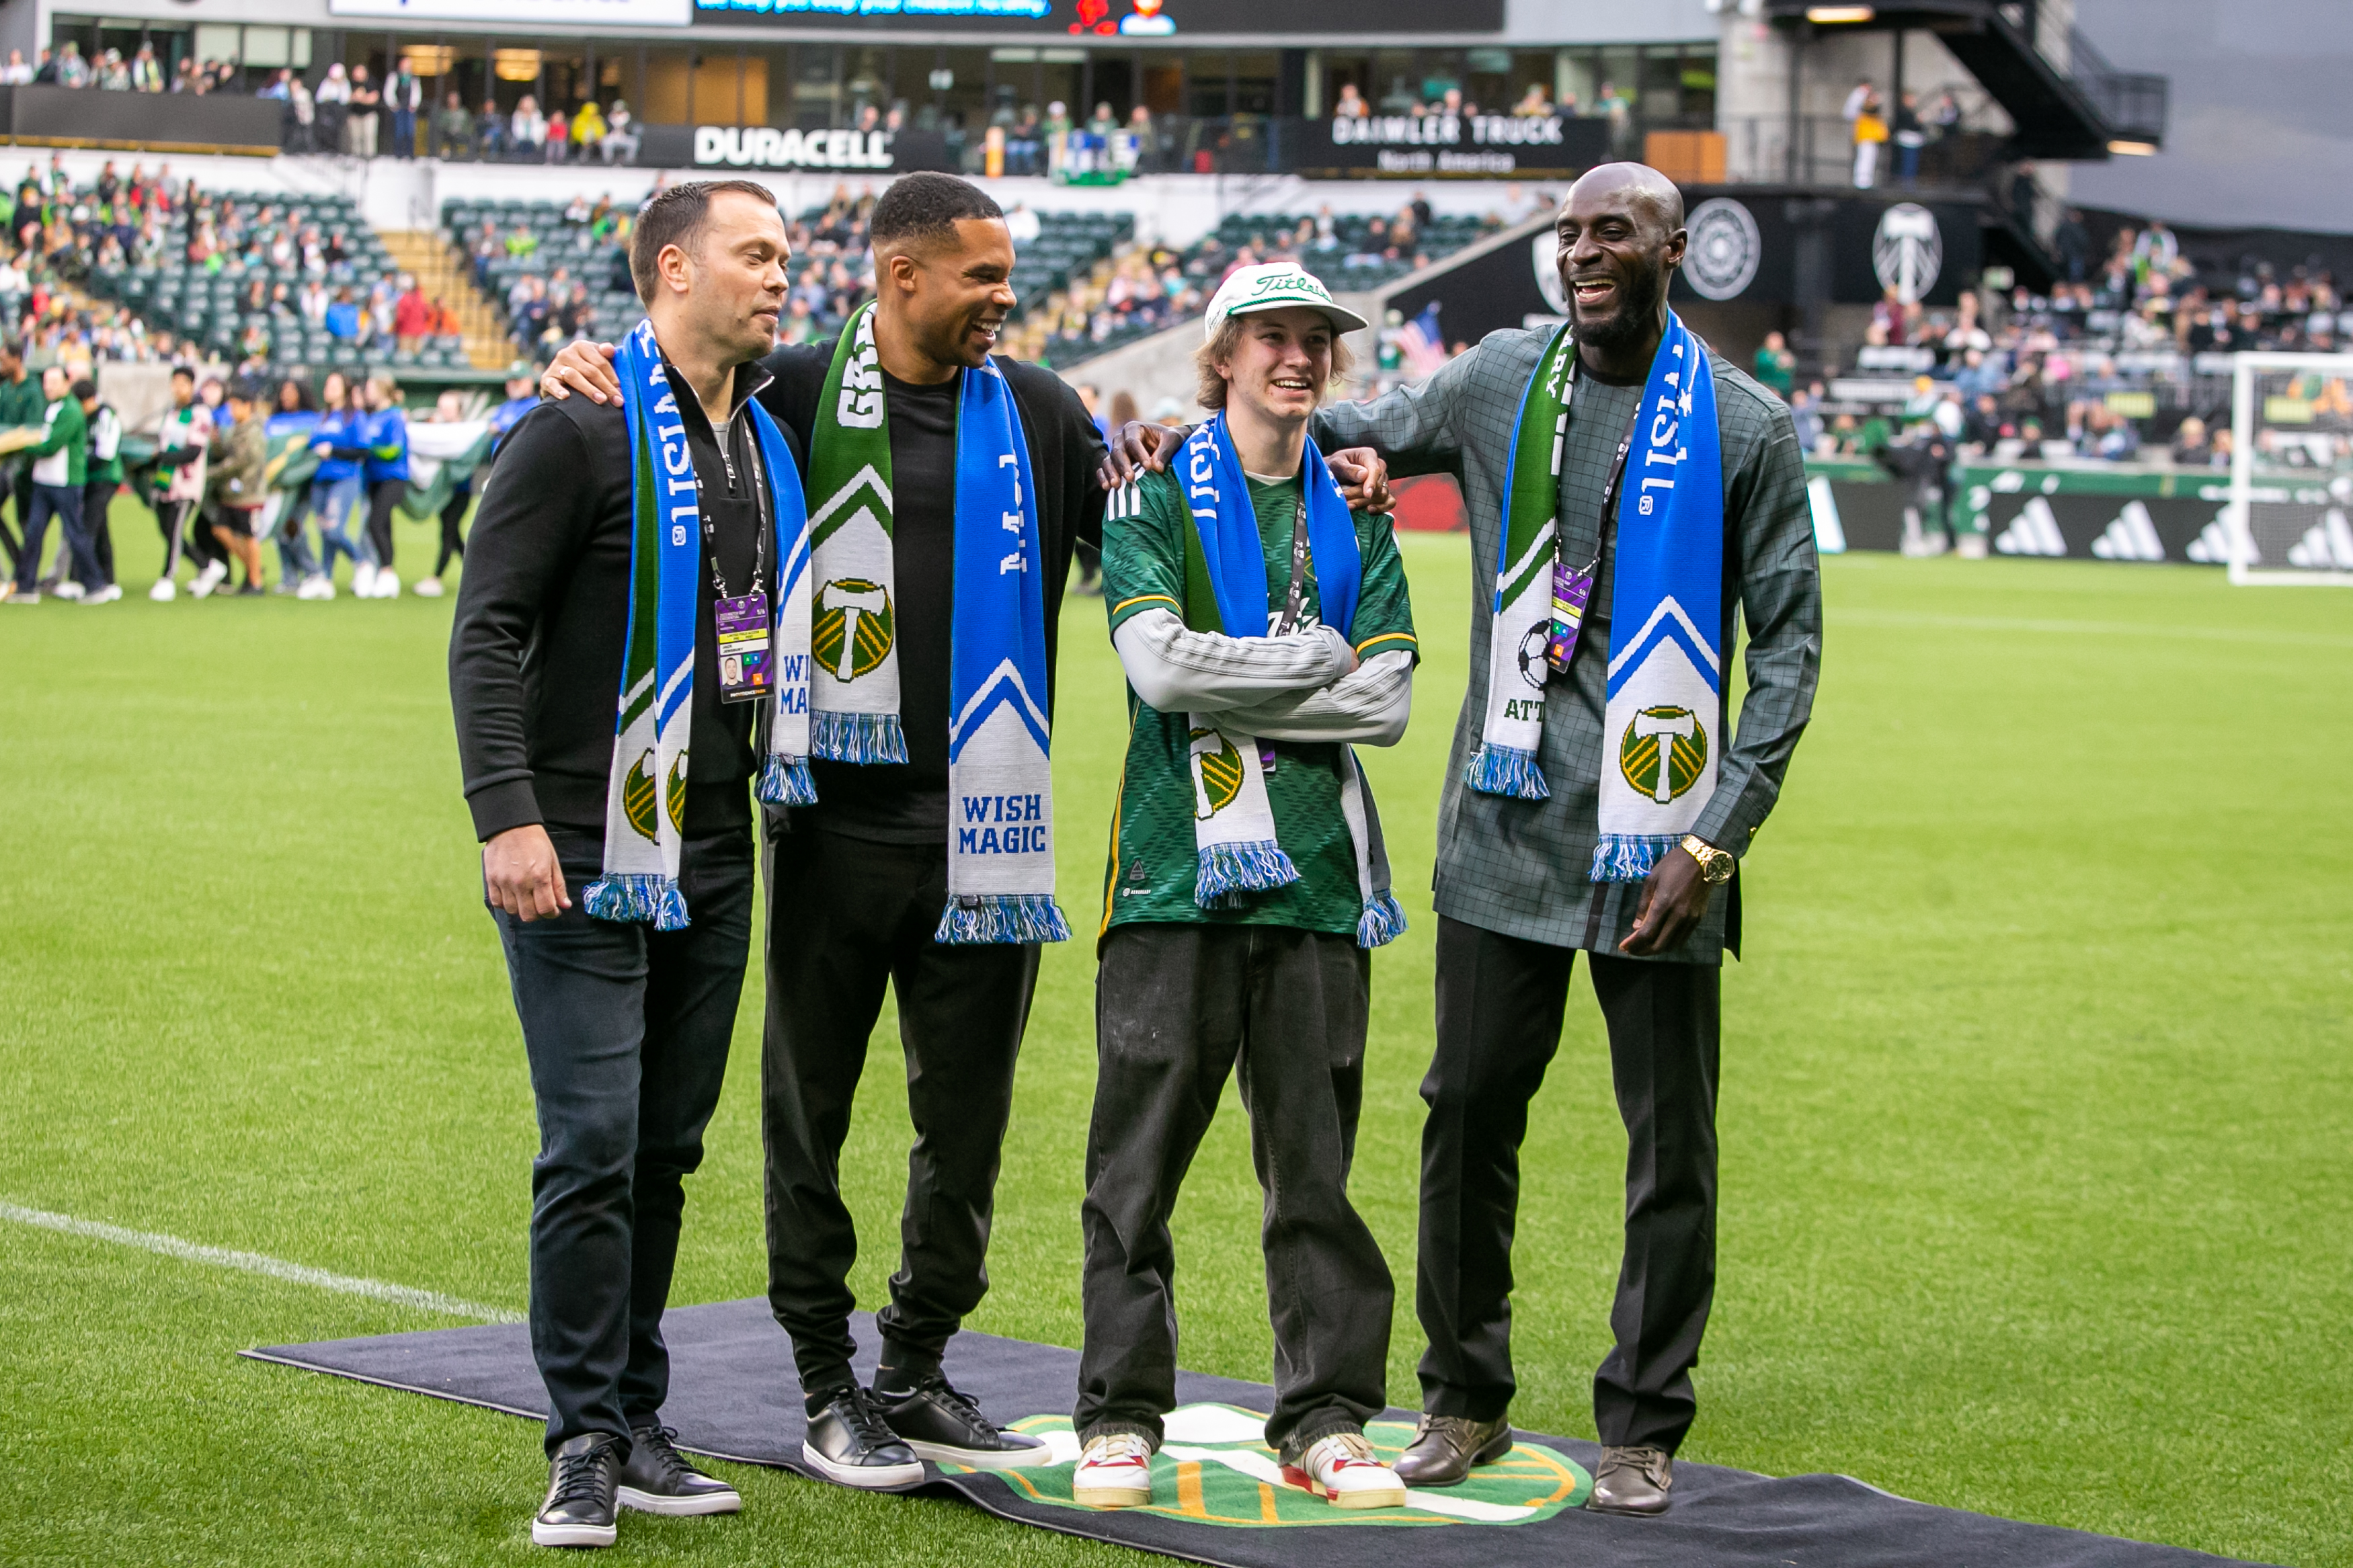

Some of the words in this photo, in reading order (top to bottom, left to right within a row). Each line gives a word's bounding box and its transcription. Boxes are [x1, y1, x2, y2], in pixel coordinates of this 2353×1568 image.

[1332, 115, 1461, 145] DAIMLER
[1471, 115, 1563, 145] TRUCK
[694, 126, 894, 168] DURACELL
[962, 794, 1041, 822] WISH
[959, 825, 1046, 854] MAGIC
